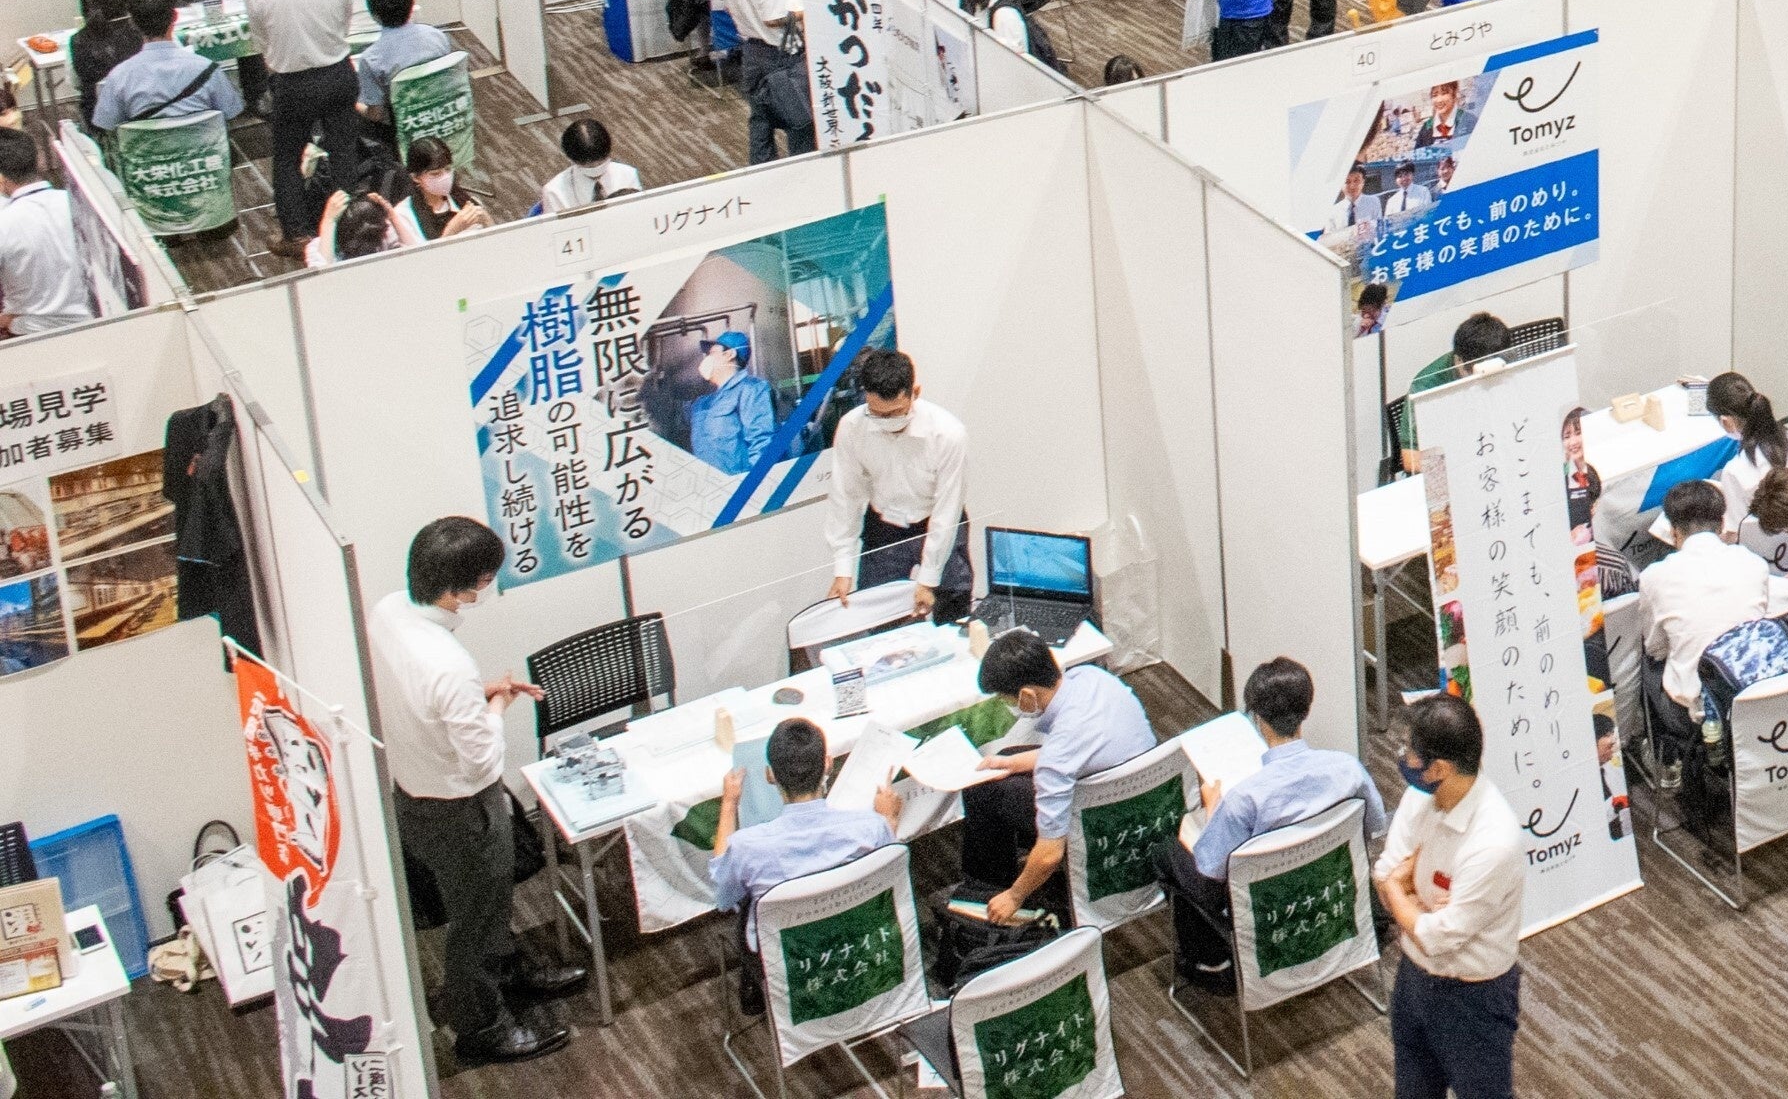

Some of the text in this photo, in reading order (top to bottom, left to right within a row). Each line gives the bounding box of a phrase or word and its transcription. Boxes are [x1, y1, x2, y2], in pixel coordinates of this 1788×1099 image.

[1429, 21, 1493, 51] とみづや
[1356, 51, 1376, 67] 40
[402, 99, 470, 128] 大栄化工機
[1508, 114, 1577, 147] Tomyz
[132, 154, 223, 183] 大栄化工機
[143, 175, 219, 198] 株式会社
[652, 195, 752, 235] リグナイト
[1370, 180, 1579, 258] どこまでも、前のめり。
[561, 236, 586, 257] 41
[1370, 204, 1593, 286] お客様の笑顔のために。
[521, 294, 595, 560] 樹脂の可能性を
[585, 284, 655, 540] 無限に広がる
[489, 389, 541, 575] 追求し続ける
[1475, 431, 1542, 790] お客様の笑顔のために。
[1512, 417, 1571, 762] どこまでも、前のめり。
[1096, 809, 1180, 851] リグナイト
[1526, 830, 1582, 867] Tomyz
[1265, 880, 1348, 924] リグナイト
[1271, 901, 1346, 945] 株式会社
[799, 927, 892, 974] リグナイト
[806, 951, 889, 993] 株式会社
[994, 1012, 1085, 1066] リグナイト
[1003, 1037, 1085, 1086] 株式会社
